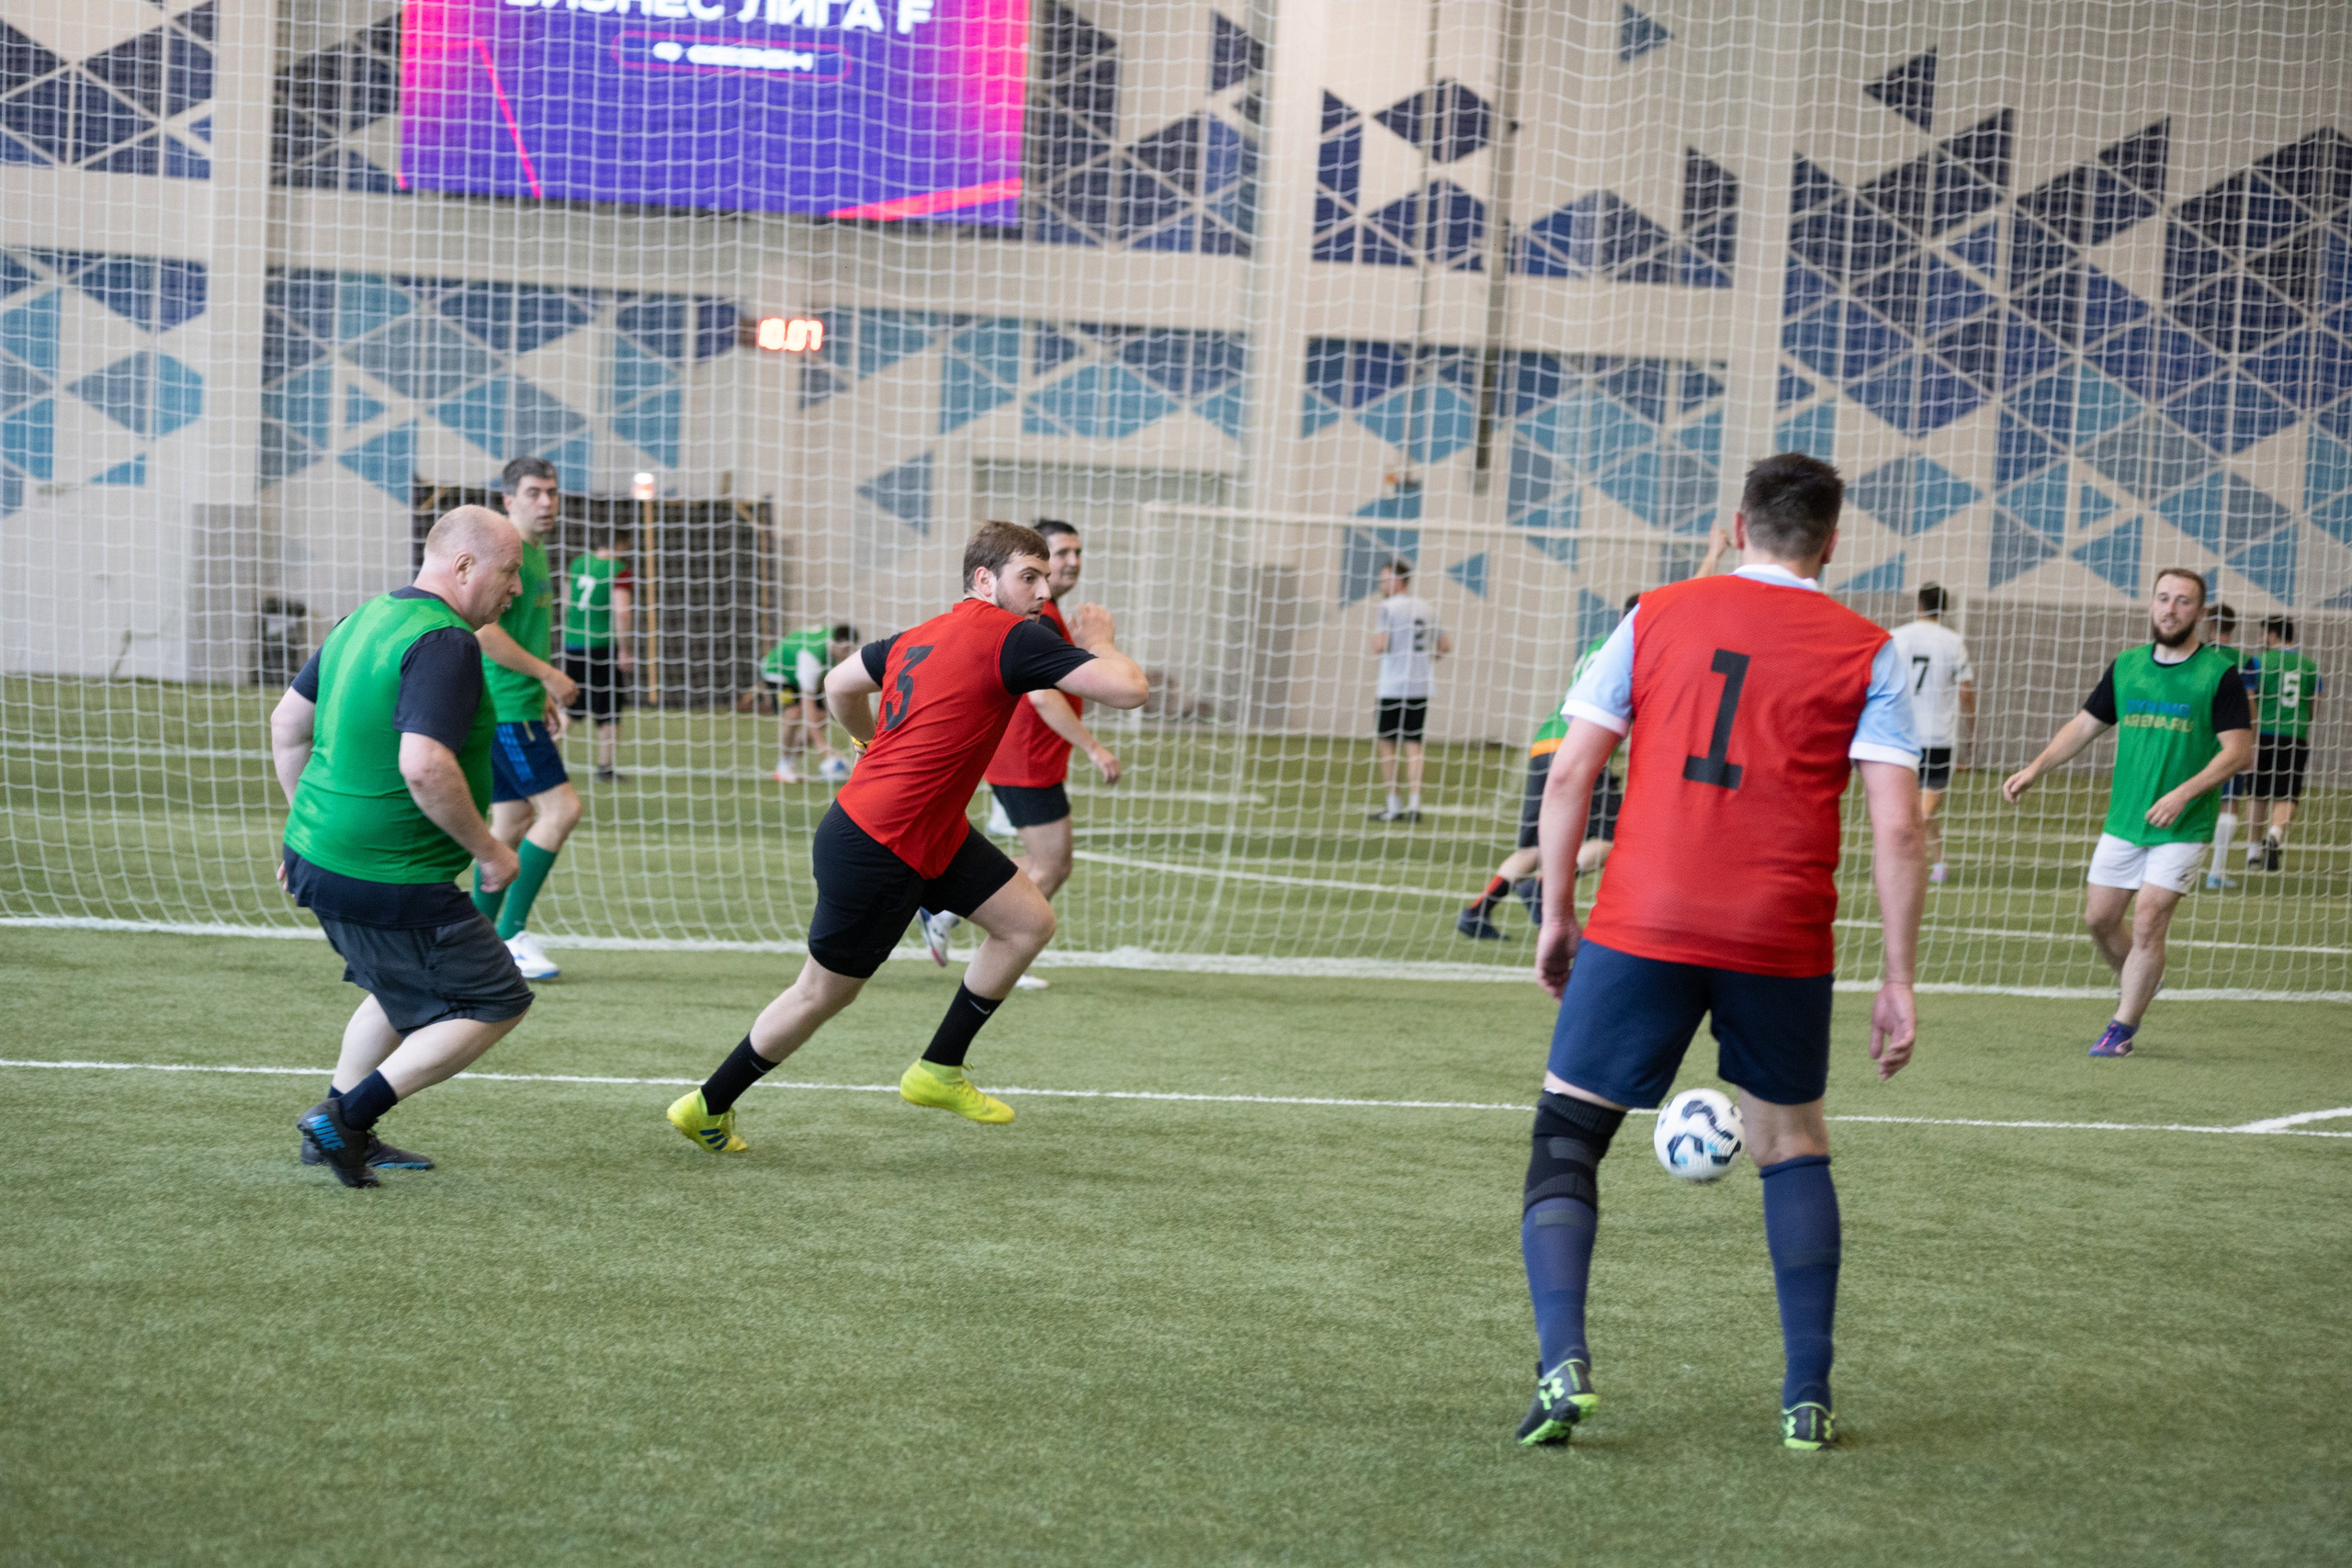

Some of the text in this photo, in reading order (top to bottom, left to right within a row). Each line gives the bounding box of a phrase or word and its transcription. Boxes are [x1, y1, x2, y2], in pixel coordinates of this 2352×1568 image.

[897, 0, 934, 34] F
[577, 575, 595, 611] 7
[884, 645, 935, 731] 3
[1912, 655, 1930, 694] 7
[2282, 671, 2300, 707] 5
[1683, 649, 1751, 790] 1
